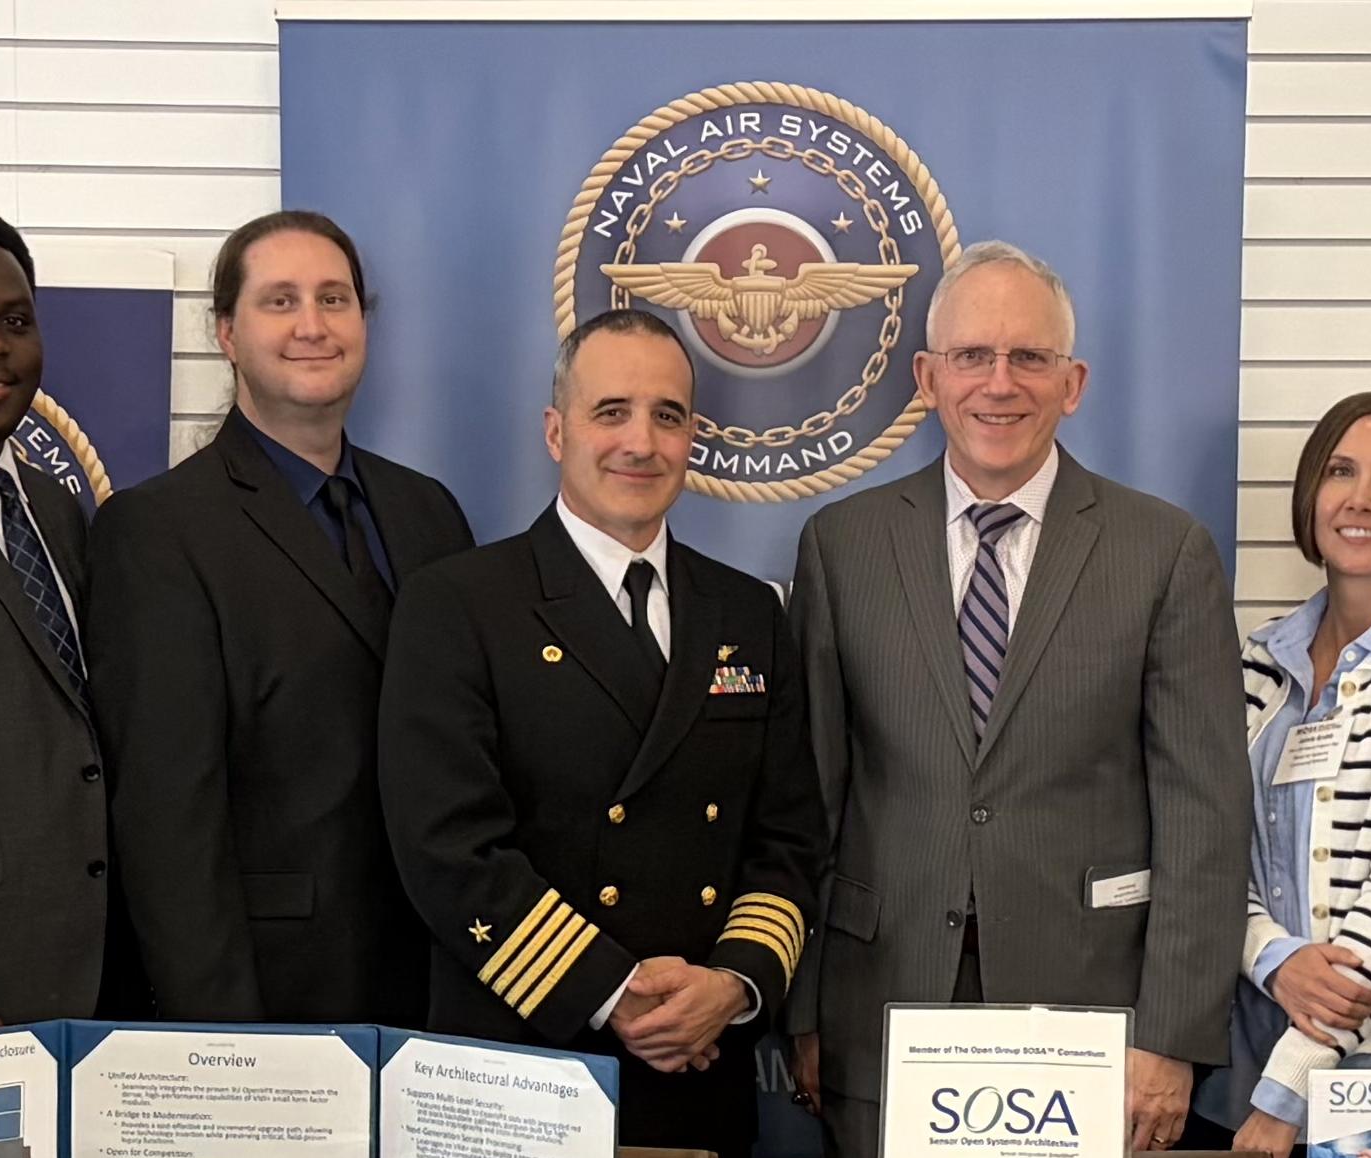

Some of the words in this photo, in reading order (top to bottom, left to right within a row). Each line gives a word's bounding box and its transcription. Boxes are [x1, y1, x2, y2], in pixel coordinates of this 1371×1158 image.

[594, 138, 687, 237] NAVAL
[700, 112, 762, 142] AIR
[779, 114, 923, 236] SYSTEMS
[16, 415, 81, 495] TEMS
[688, 431, 853, 475] OMMAND
[909, 1046, 941, 1054] Member
[944, 1046, 952, 1054] of
[954, 1046, 969, 1054] The
[970, 1047, 993, 1055] Open
[995, 1047, 1020, 1056] Group
[188, 1052, 256, 1067] Overview
[414, 1061, 433, 1077] Key
[436, 1065, 510, 1087] Architectural
[513, 1077, 578, 1099] Advantages
[106, 1110, 113, 1118] A
[929, 1137, 958, 1145] Sensor
[961, 1137, 984, 1146] Open
[986, 1137, 1022, 1147] Systems
[1024, 1138, 1079, 1148] Architecture
[106, 1148, 129, 1158] Open
[131, 1148, 142, 1156] for
